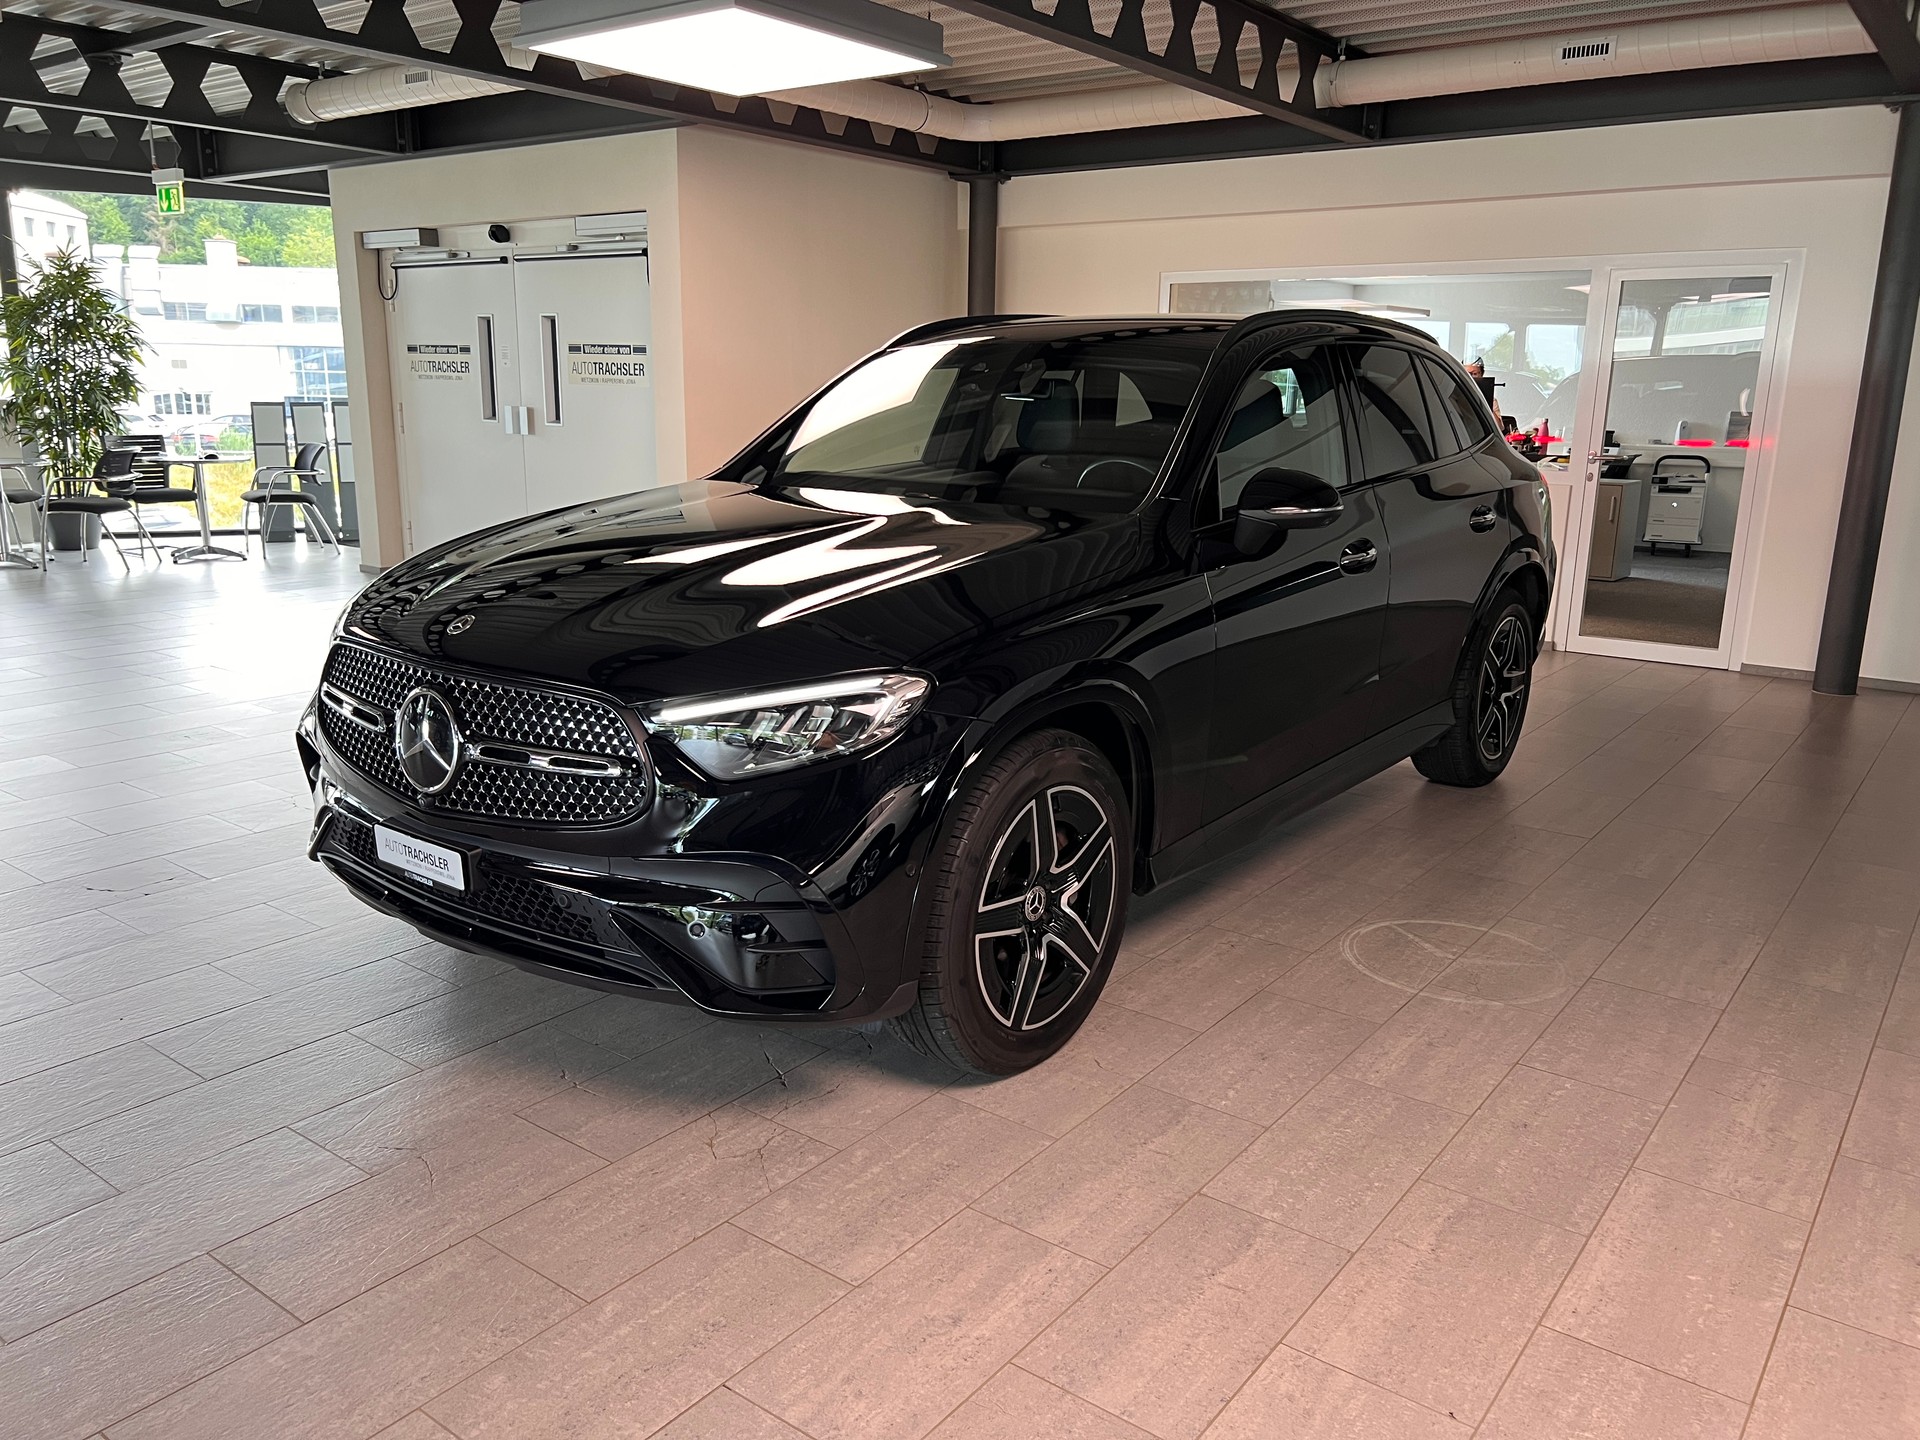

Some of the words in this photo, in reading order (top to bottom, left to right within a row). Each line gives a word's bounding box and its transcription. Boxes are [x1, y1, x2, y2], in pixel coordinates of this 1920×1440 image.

[411, 360, 470, 373] AUTOTRACHSLER
[572, 361, 645, 376] AUTOTRACHSLER
[385, 838, 449, 871] AUTOTRACHSLER
